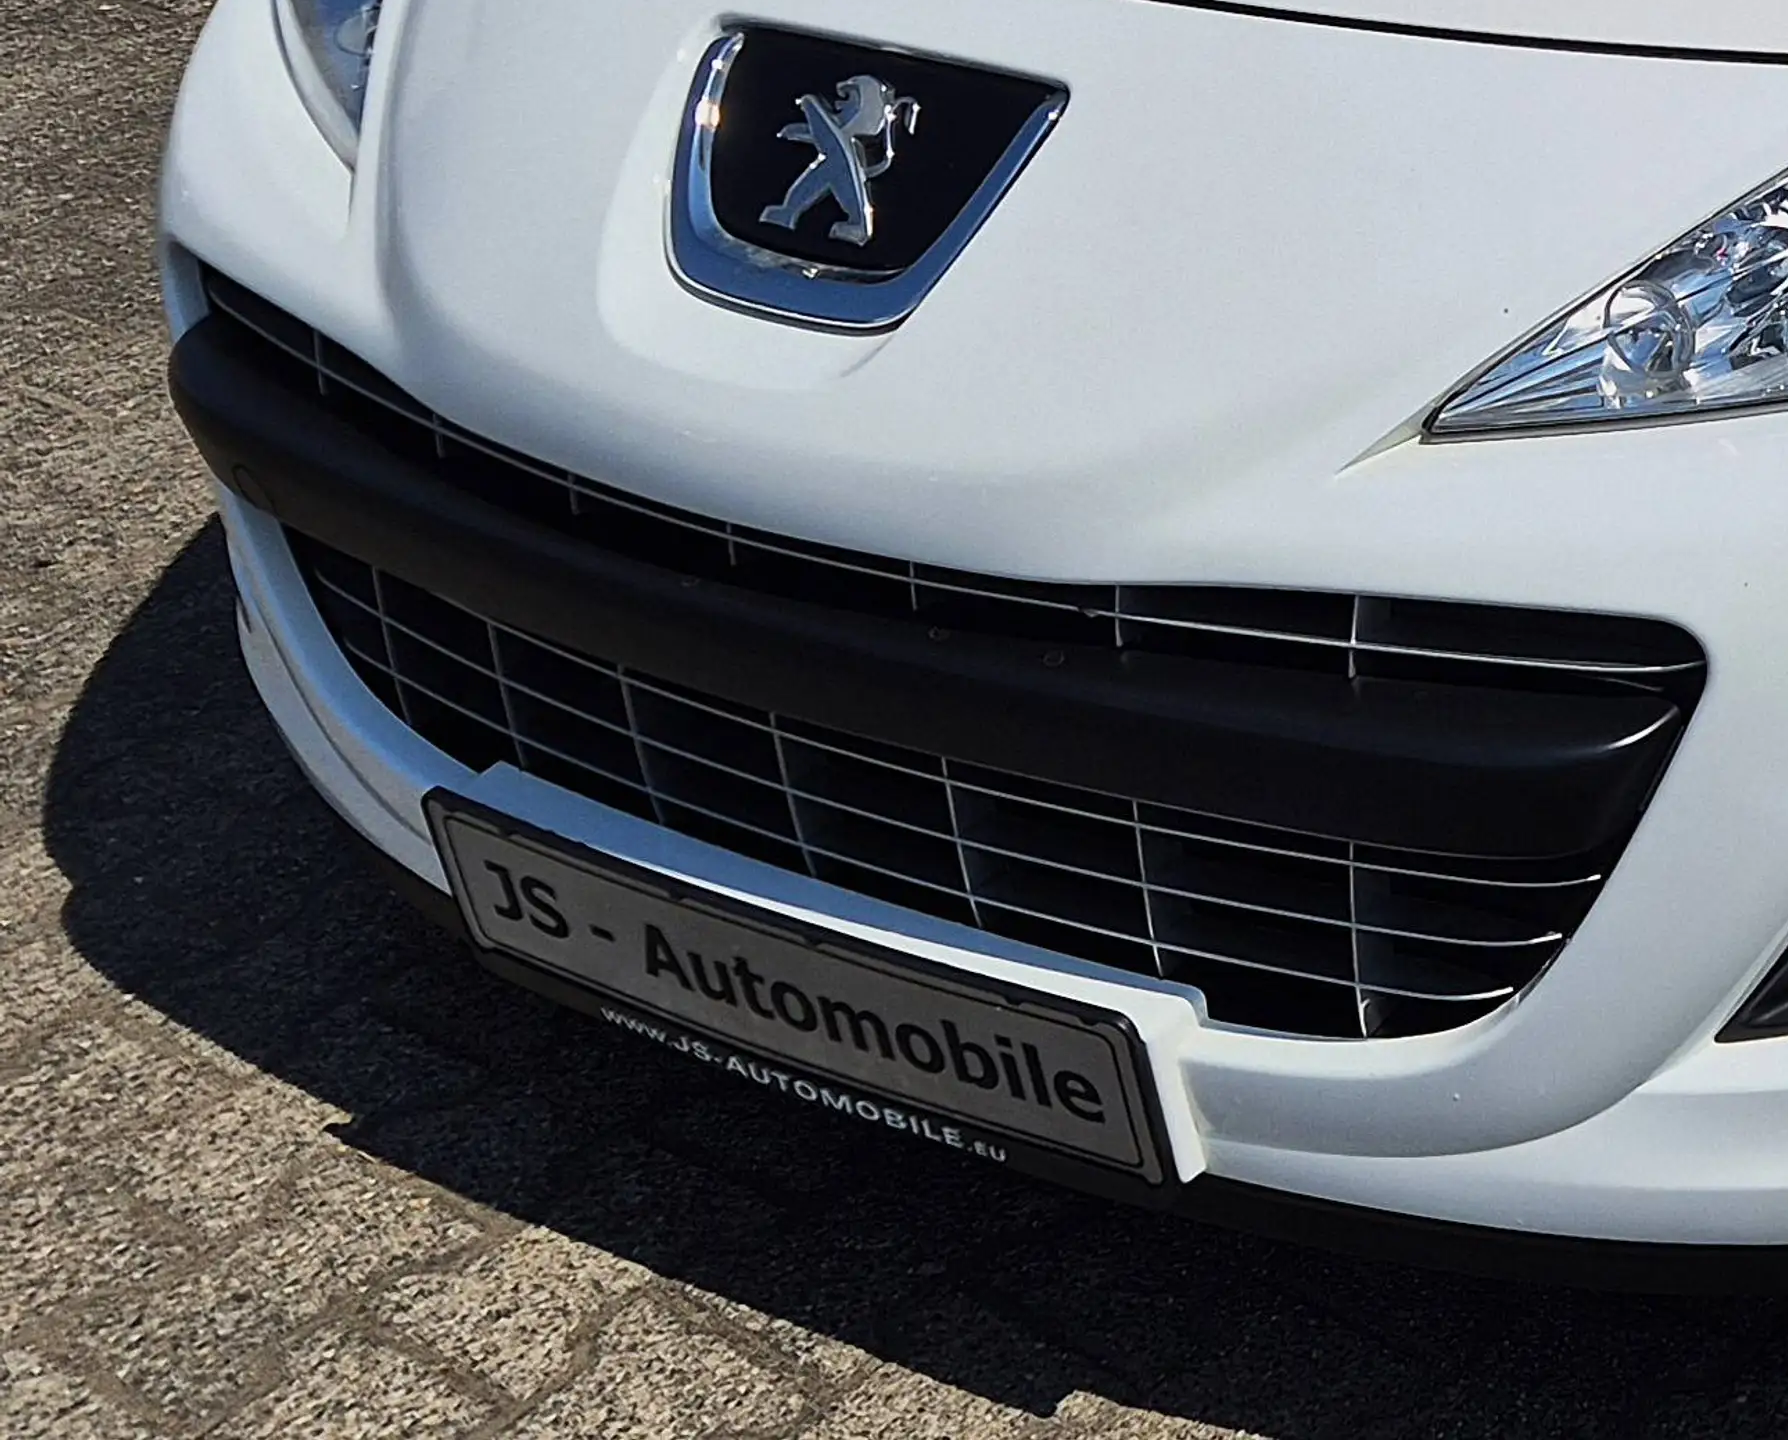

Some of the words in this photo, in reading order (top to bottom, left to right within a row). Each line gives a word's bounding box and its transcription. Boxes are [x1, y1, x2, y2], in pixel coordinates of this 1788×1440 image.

[484, 859, 570, 939] JS
[590, 923, 616, 943] -
[644, 923, 1106, 1125] Automobile
